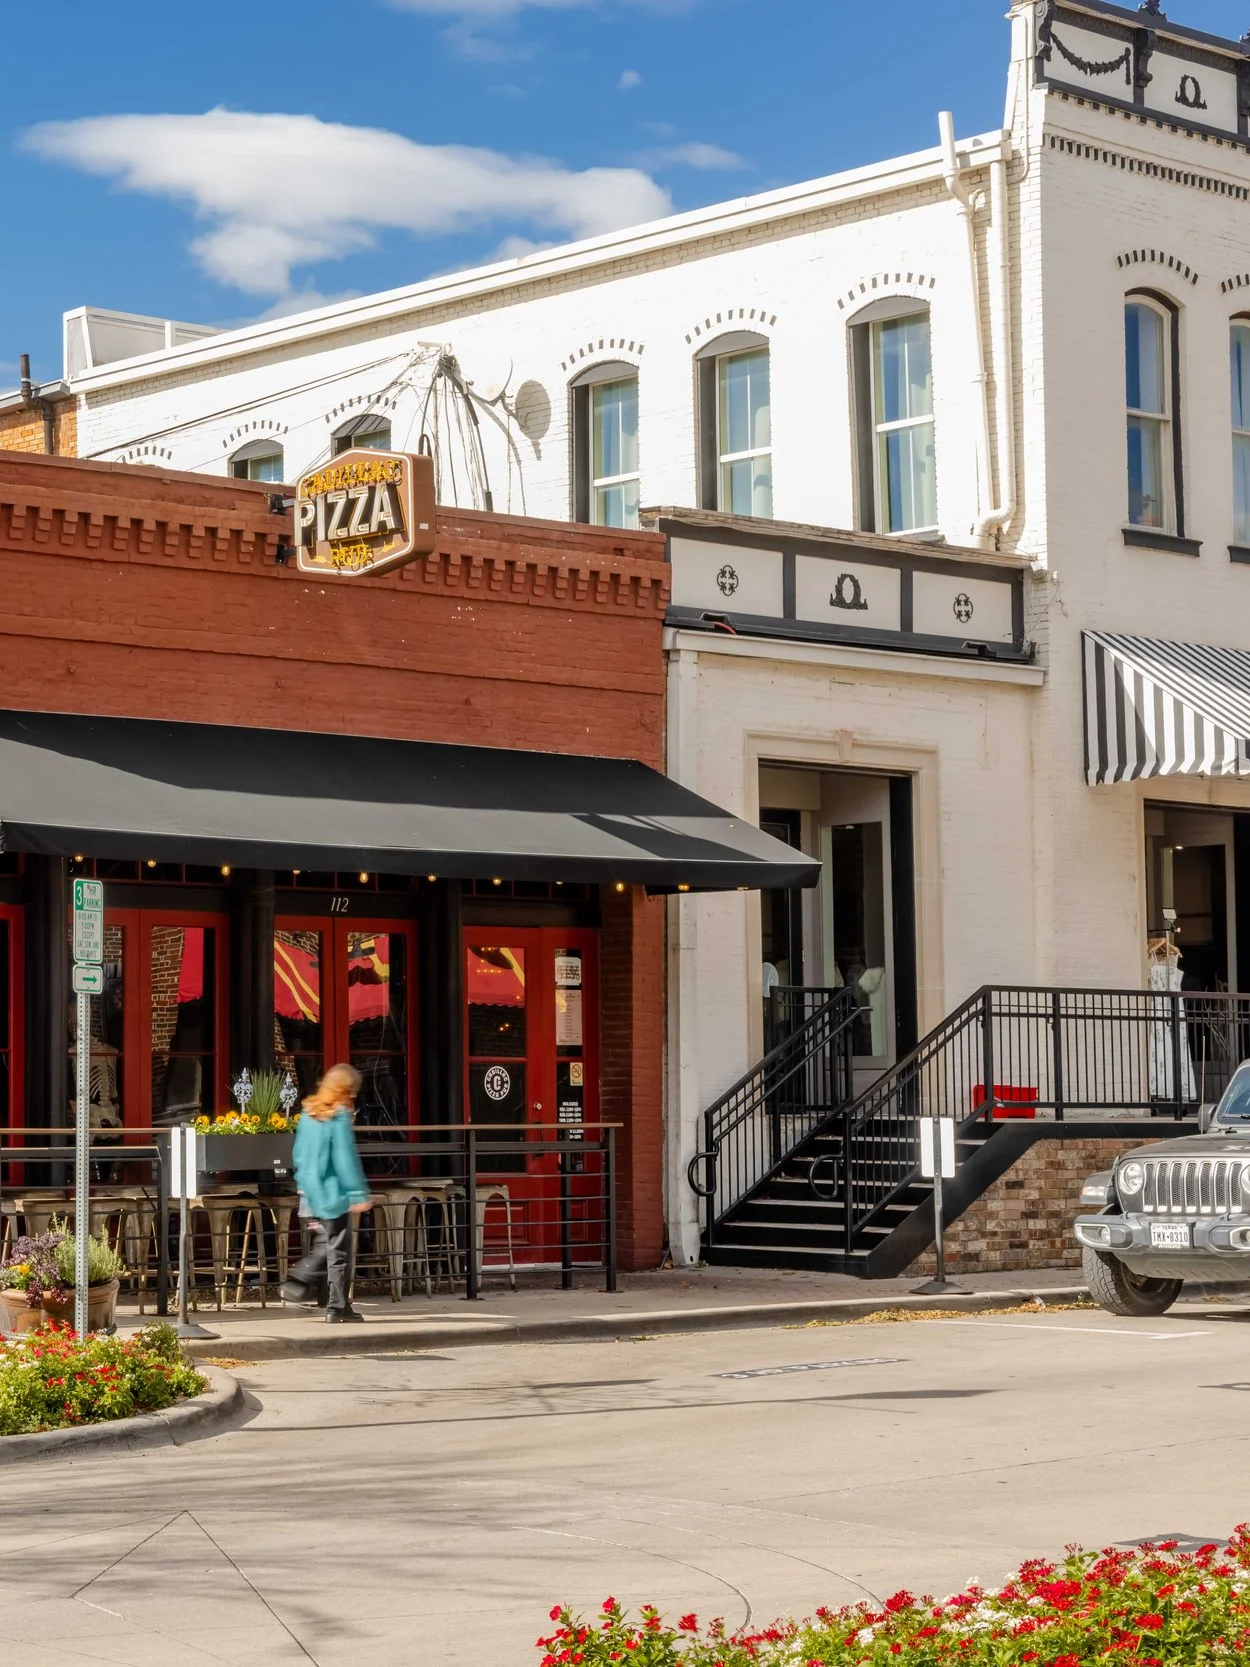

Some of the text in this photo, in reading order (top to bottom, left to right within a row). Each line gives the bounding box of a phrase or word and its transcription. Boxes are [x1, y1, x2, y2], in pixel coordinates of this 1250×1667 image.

[301, 459, 401, 497] CADILLAC
[294, 481, 397, 546] PIZZA
[76, 886, 83, 906] 3
[84, 898, 101, 909] PARKING
[330, 896, 350, 912] 112
